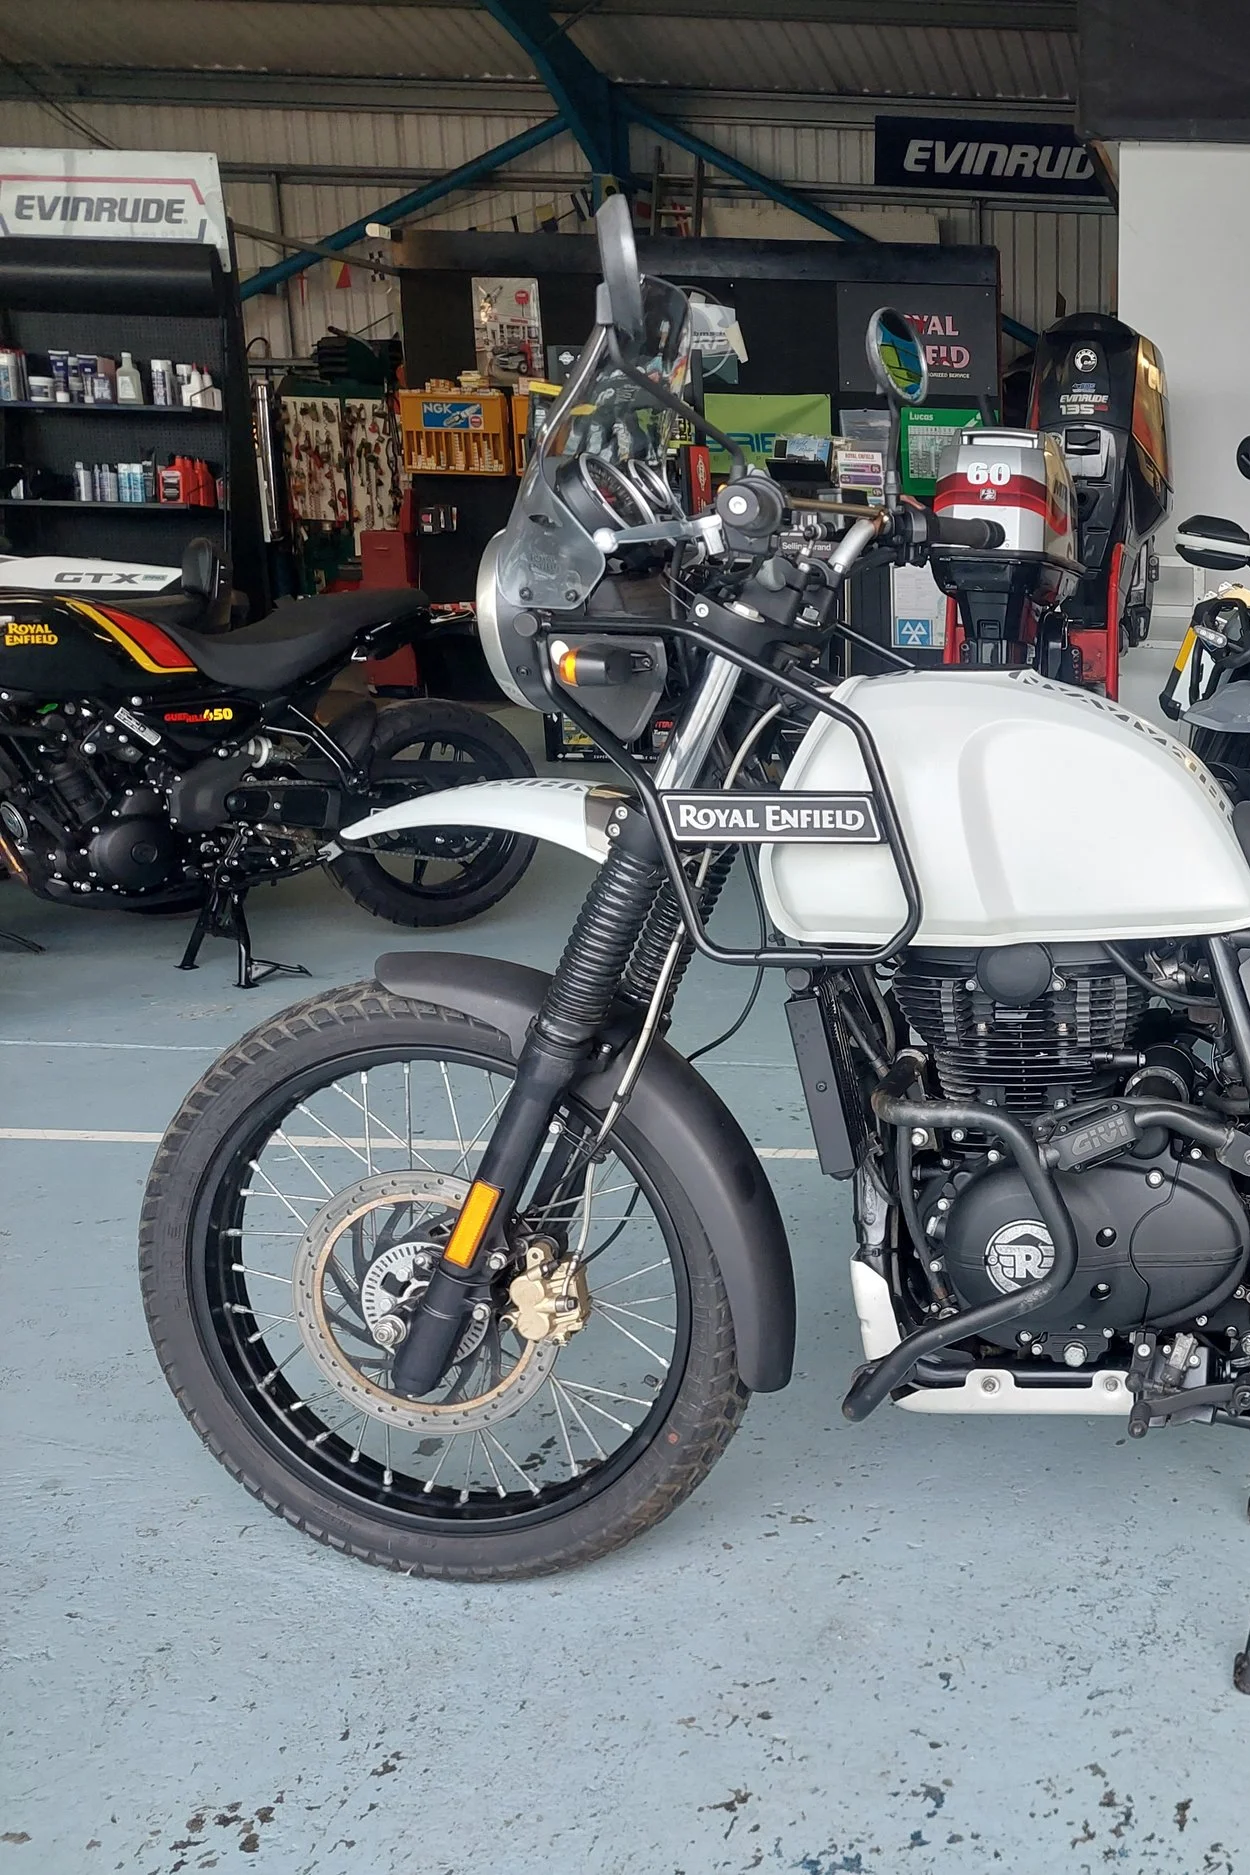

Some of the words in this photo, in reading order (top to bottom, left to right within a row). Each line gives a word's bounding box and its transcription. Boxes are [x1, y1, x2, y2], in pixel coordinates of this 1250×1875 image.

[903, 139, 1095, 180] EVINRUD
[15, 195, 188, 224] EVINRUDE
[1060, 394, 1108, 403] EVINRUDE
[423, 403, 452, 414] NGK
[1060, 404, 1094, 415] 135
[909, 412, 934, 421] Lucas
[967, 462, 1011, 485] 60
[54, 572, 139, 584] GTX
[8, 622, 52, 635] ROYAL
[5, 632, 59, 647] ENFIELD
[203, 708, 233, 721] 450
[679, 804, 760, 830] ROYAL
[765, 805, 865, 832] ENFIELD
[1071, 1117, 1128, 1156] GIVI
